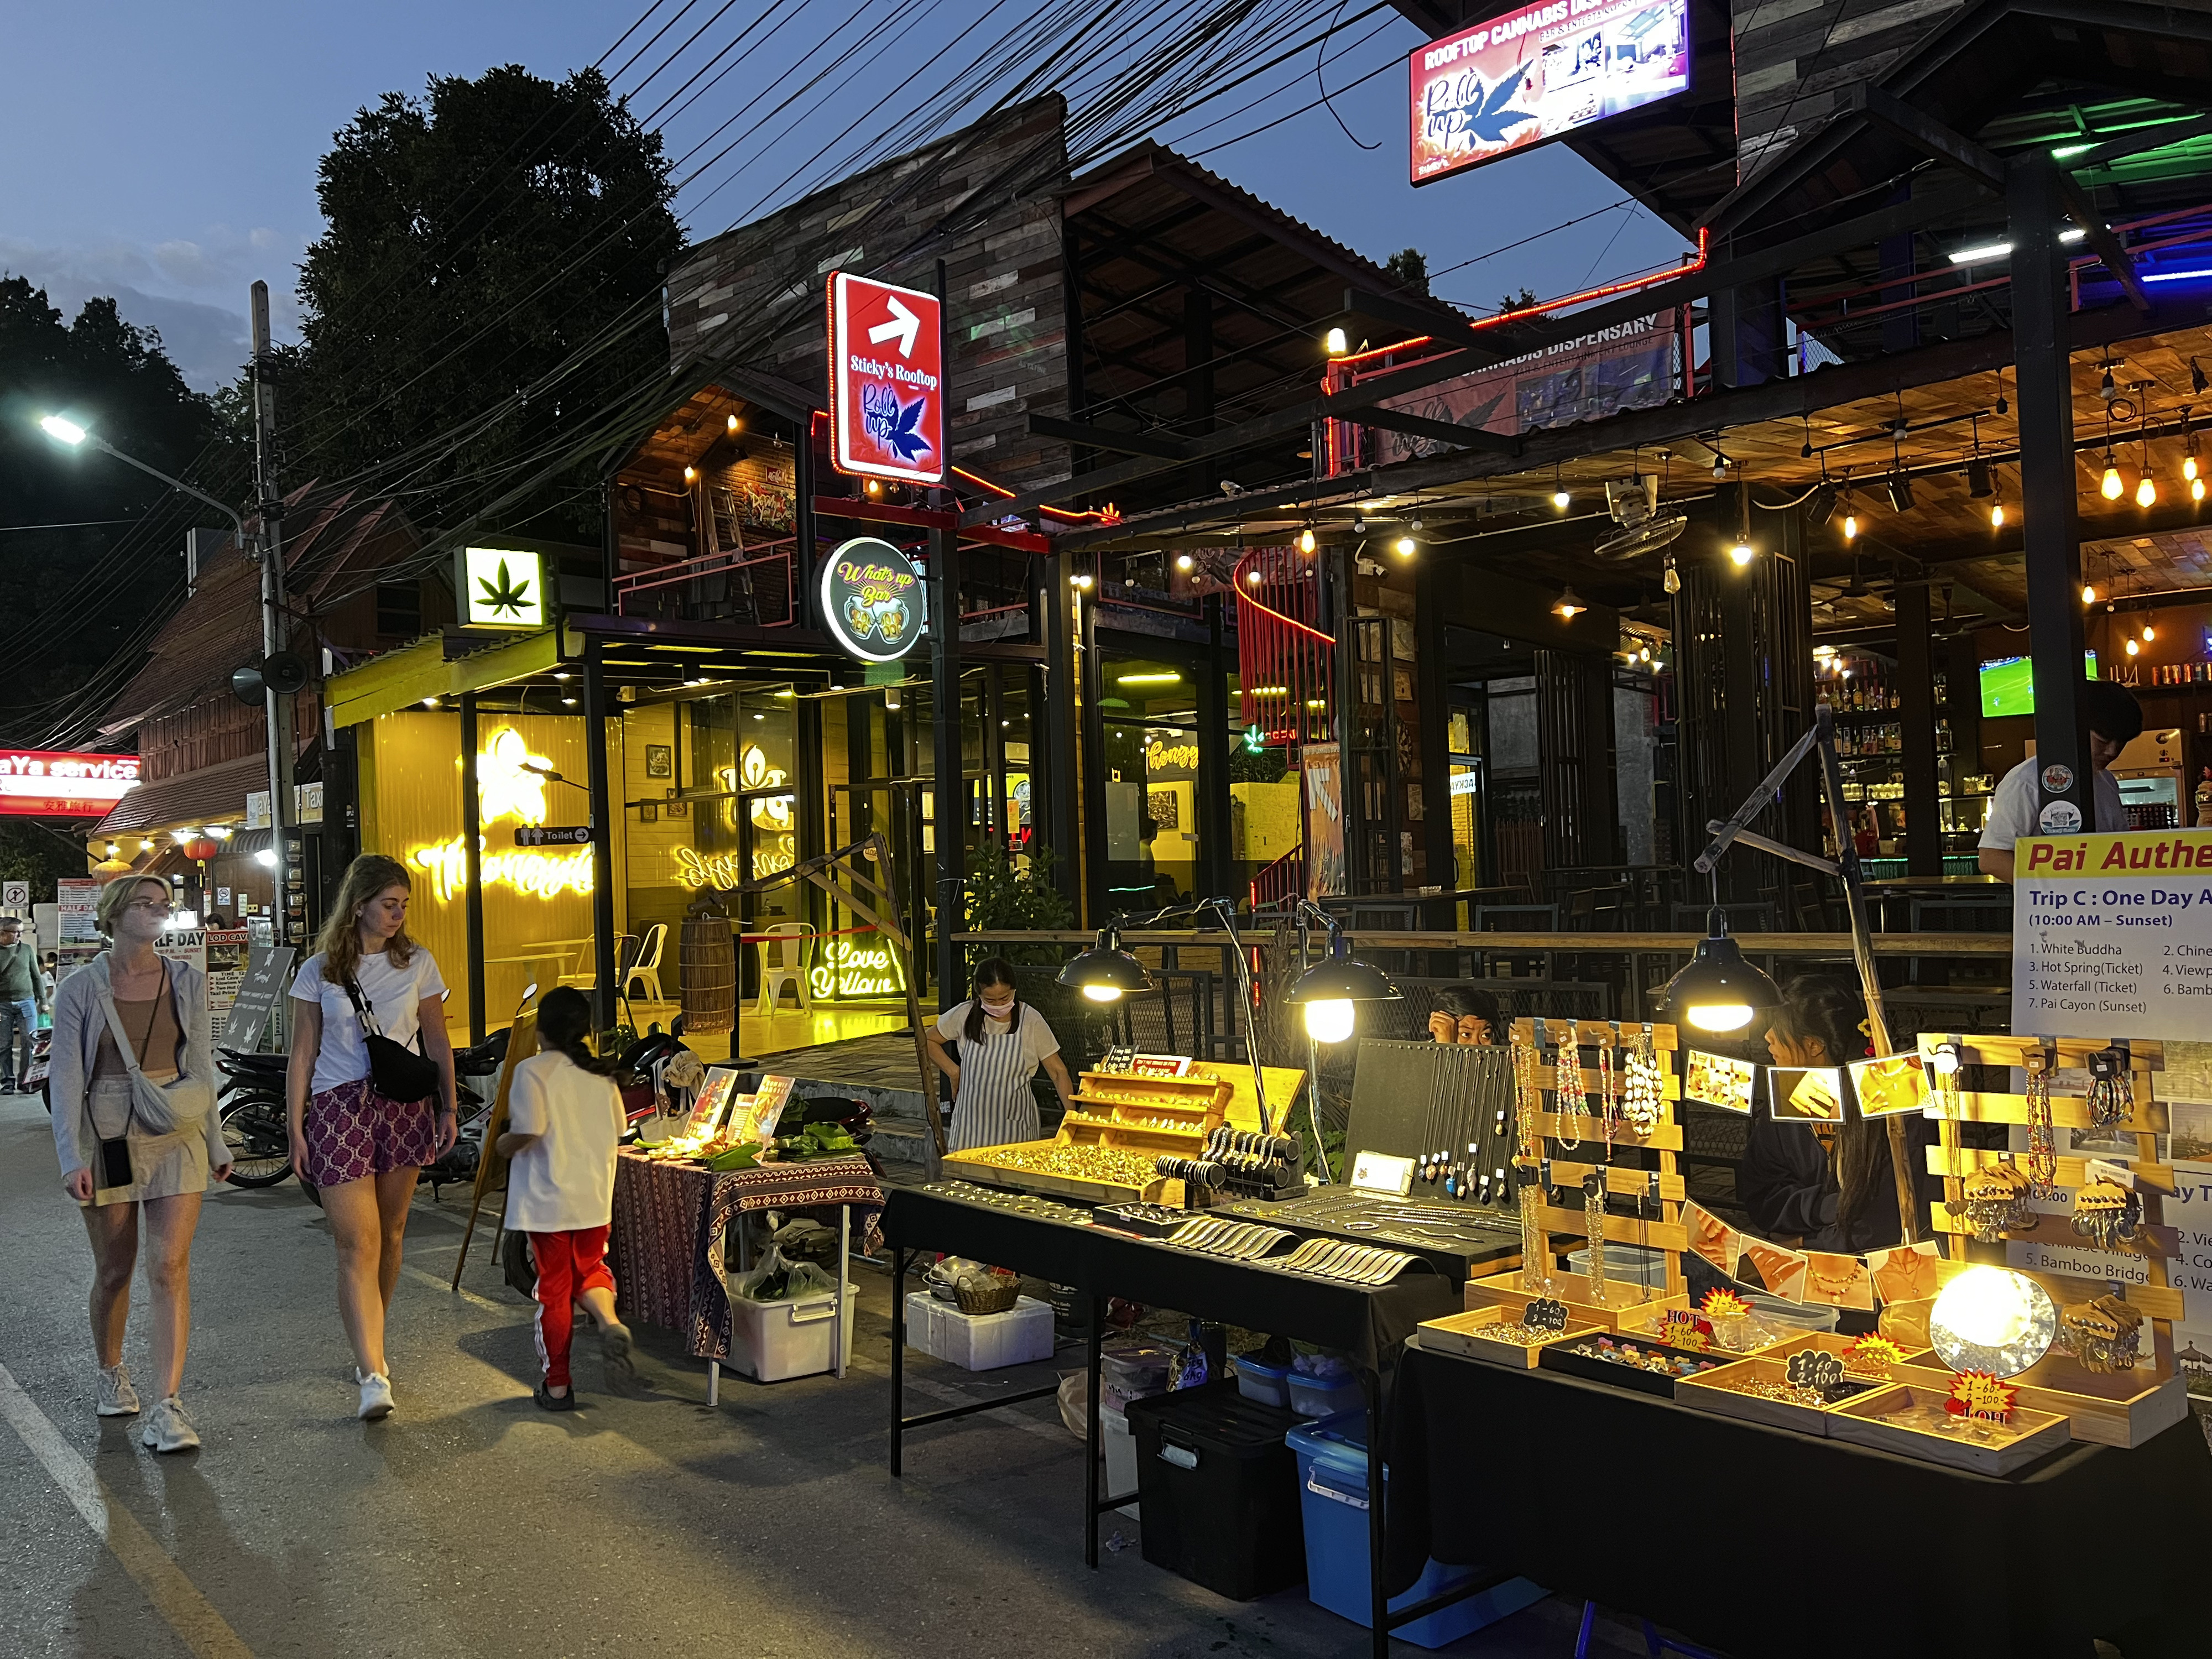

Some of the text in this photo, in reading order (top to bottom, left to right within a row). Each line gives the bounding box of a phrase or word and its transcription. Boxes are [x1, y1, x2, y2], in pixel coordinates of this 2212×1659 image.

[1425, 31, 1488, 70] ROOFTOP
[1491, 1, 1568, 45] CANNABIS
[1548, 313, 1658, 355] DISPENSARY
[1543, 347, 1615, 370] ENTERTAINMENT
[1619, 337, 1654, 352] LOUNGE
[851, 355, 937, 390] Sticky's Rooftop
[863, 384, 896, 417] Roll
[866, 416, 892, 450] up
[837, 561, 914, 589] What's up
[861, 585, 892, 608] Bar
[50, 760, 138, 780] service
[546, 831, 573, 840] Toilet
[2028, 839, 2212, 871] Pai Authe
[2029, 890, 2068, 910] Trip
[2073, 890, 2086, 906] C
[2103, 890, 2145, 906] One
[2152, 889, 2193, 910] Day
[2029, 914, 2073, 927] (10:00
[2076, 915, 2100, 926] AM
[2116, 914, 2173, 927] Sunset)
[155, 932, 205, 947] LF DAY
[2031, 943, 2212, 957] 1. White Buddha 2. Chine
[825, 941, 889, 969] Love
[2029, 961, 2212, 979] 3. Hot Spring(Ticket) 4. Viewp
[2029, 979, 2212, 995] 5. Waterfall (Ticket) 6. Bamb
[2028, 998, 2147, 1015] 7. Pai Cayon (Sunset)
[2026, 1253, 2037, 1265] 5.
[2041, 1255, 2101, 1275] Bamboo
[2174, 1275, 2188, 1288] 6.
[1666, 1309, 1700, 1327] HOT
